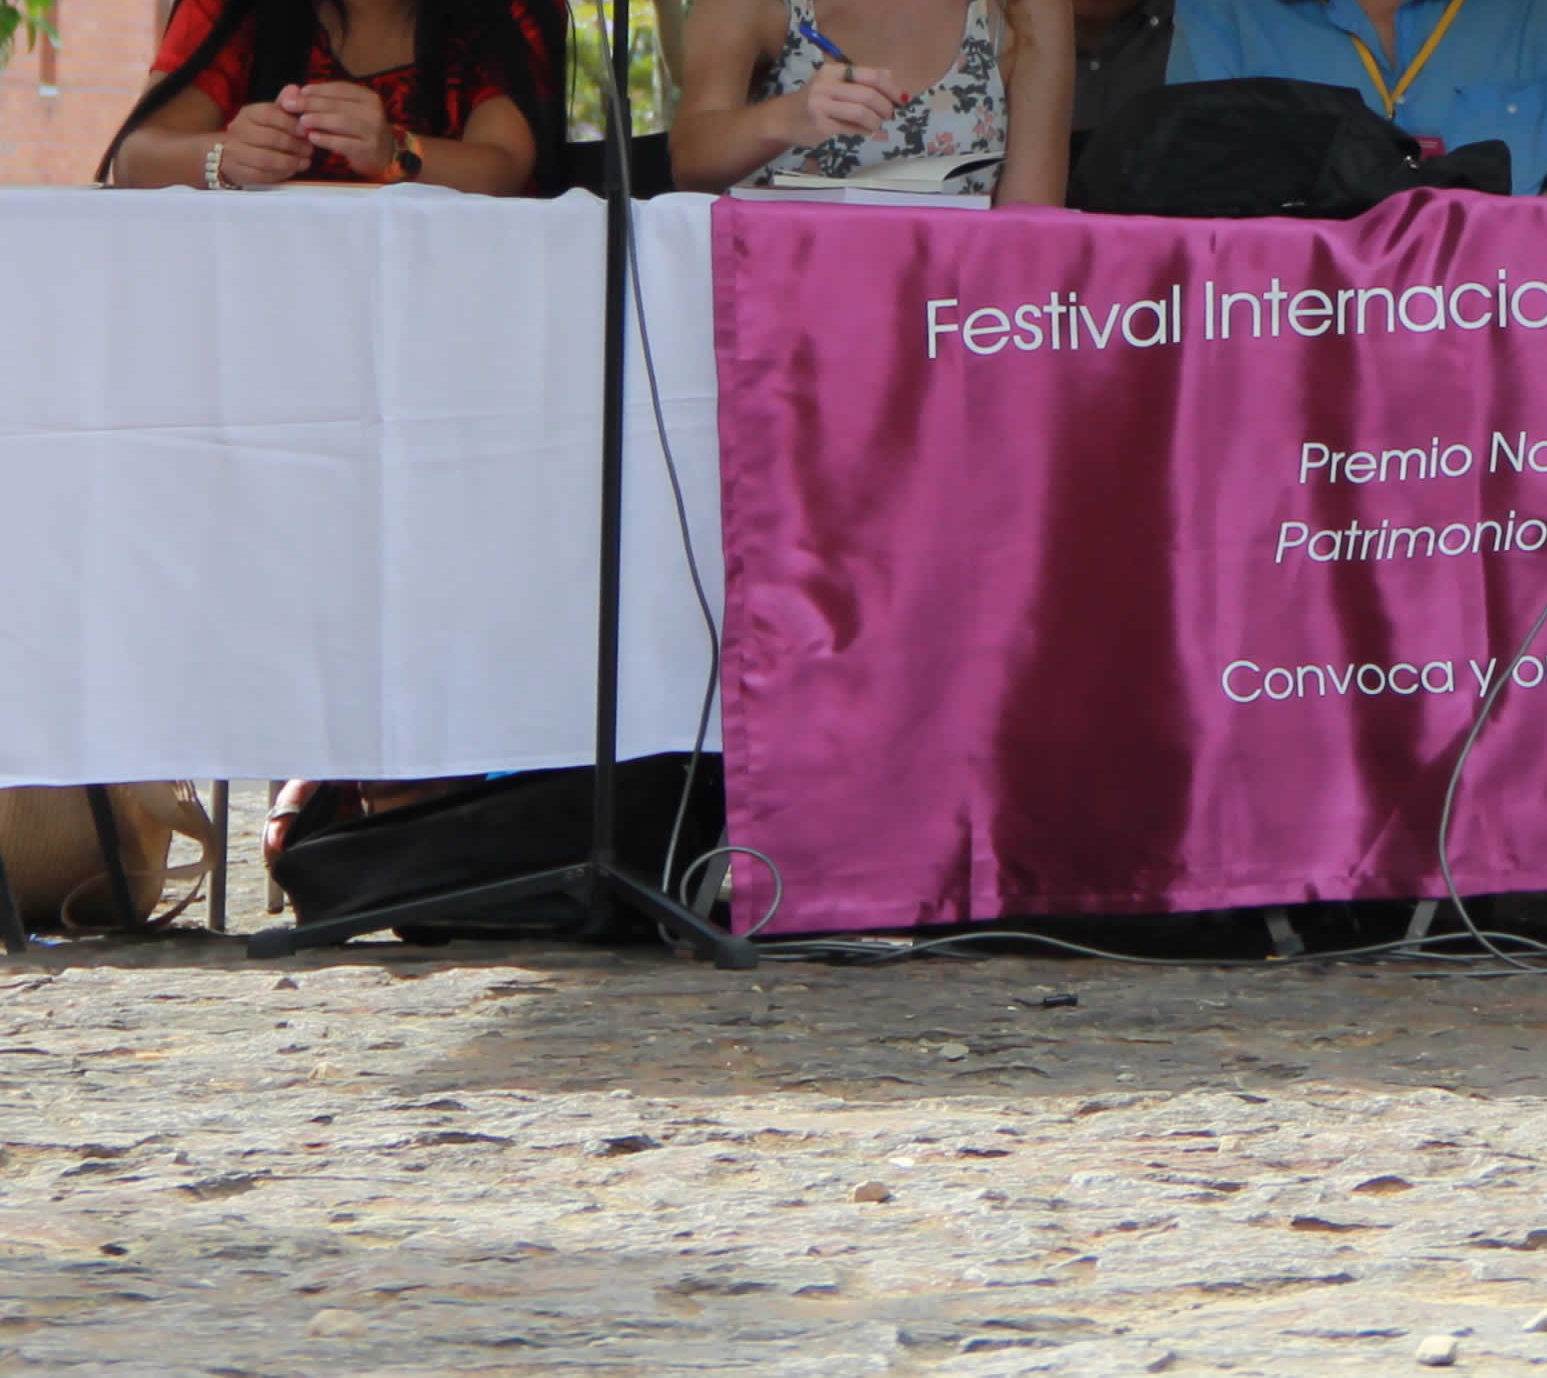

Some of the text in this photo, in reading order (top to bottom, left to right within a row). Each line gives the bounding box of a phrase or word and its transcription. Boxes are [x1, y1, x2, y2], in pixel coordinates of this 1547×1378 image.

[927, 284, 1181, 359] Festival
[1299, 434, 1473, 484] Premio
[1275, 510, 1547, 564] Patrimonio
[1221, 660, 1454, 703] Convoca
[1469, 658, 1497, 698] y
